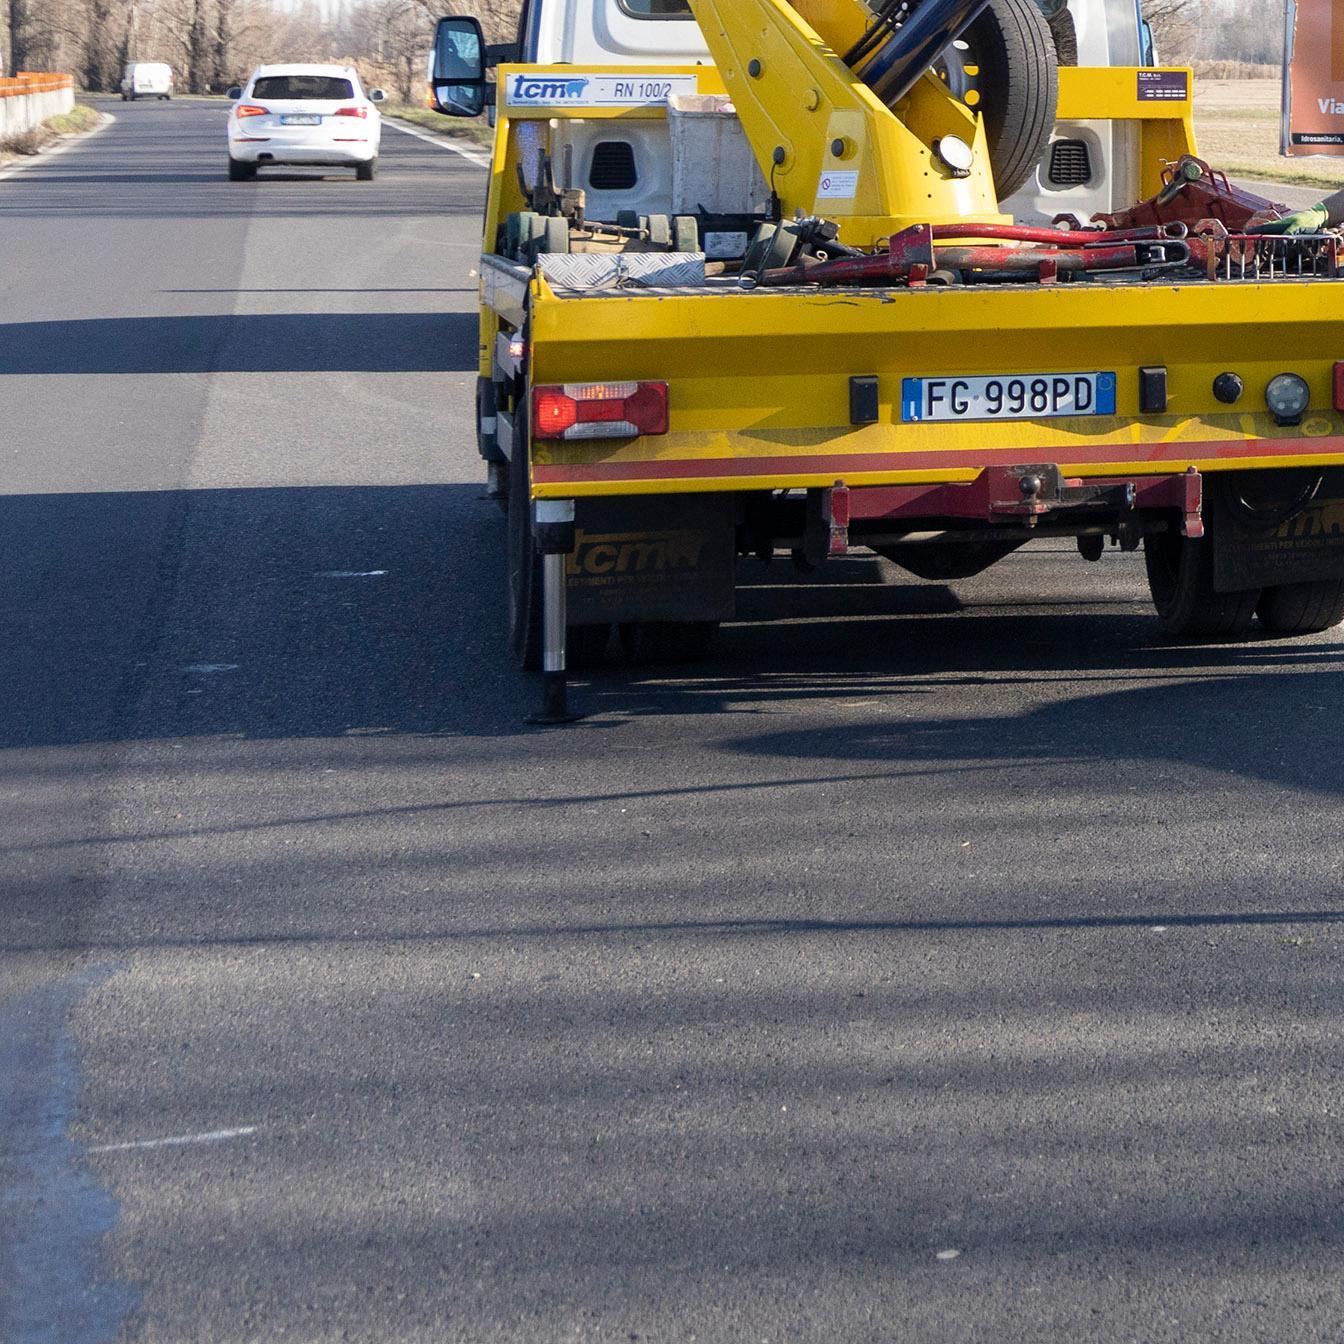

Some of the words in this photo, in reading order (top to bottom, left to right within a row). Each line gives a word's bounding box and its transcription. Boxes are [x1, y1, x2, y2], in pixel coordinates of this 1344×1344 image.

[513, 74, 577, 99] tcm
[614, 83, 633, 98] RN
[639, 83, 672, 98] 100/2
[1301, 135, 1343, 144] Idrosanitaria,
[927, 381, 969, 416] FG
[985, 376, 1092, 414] 998PD
